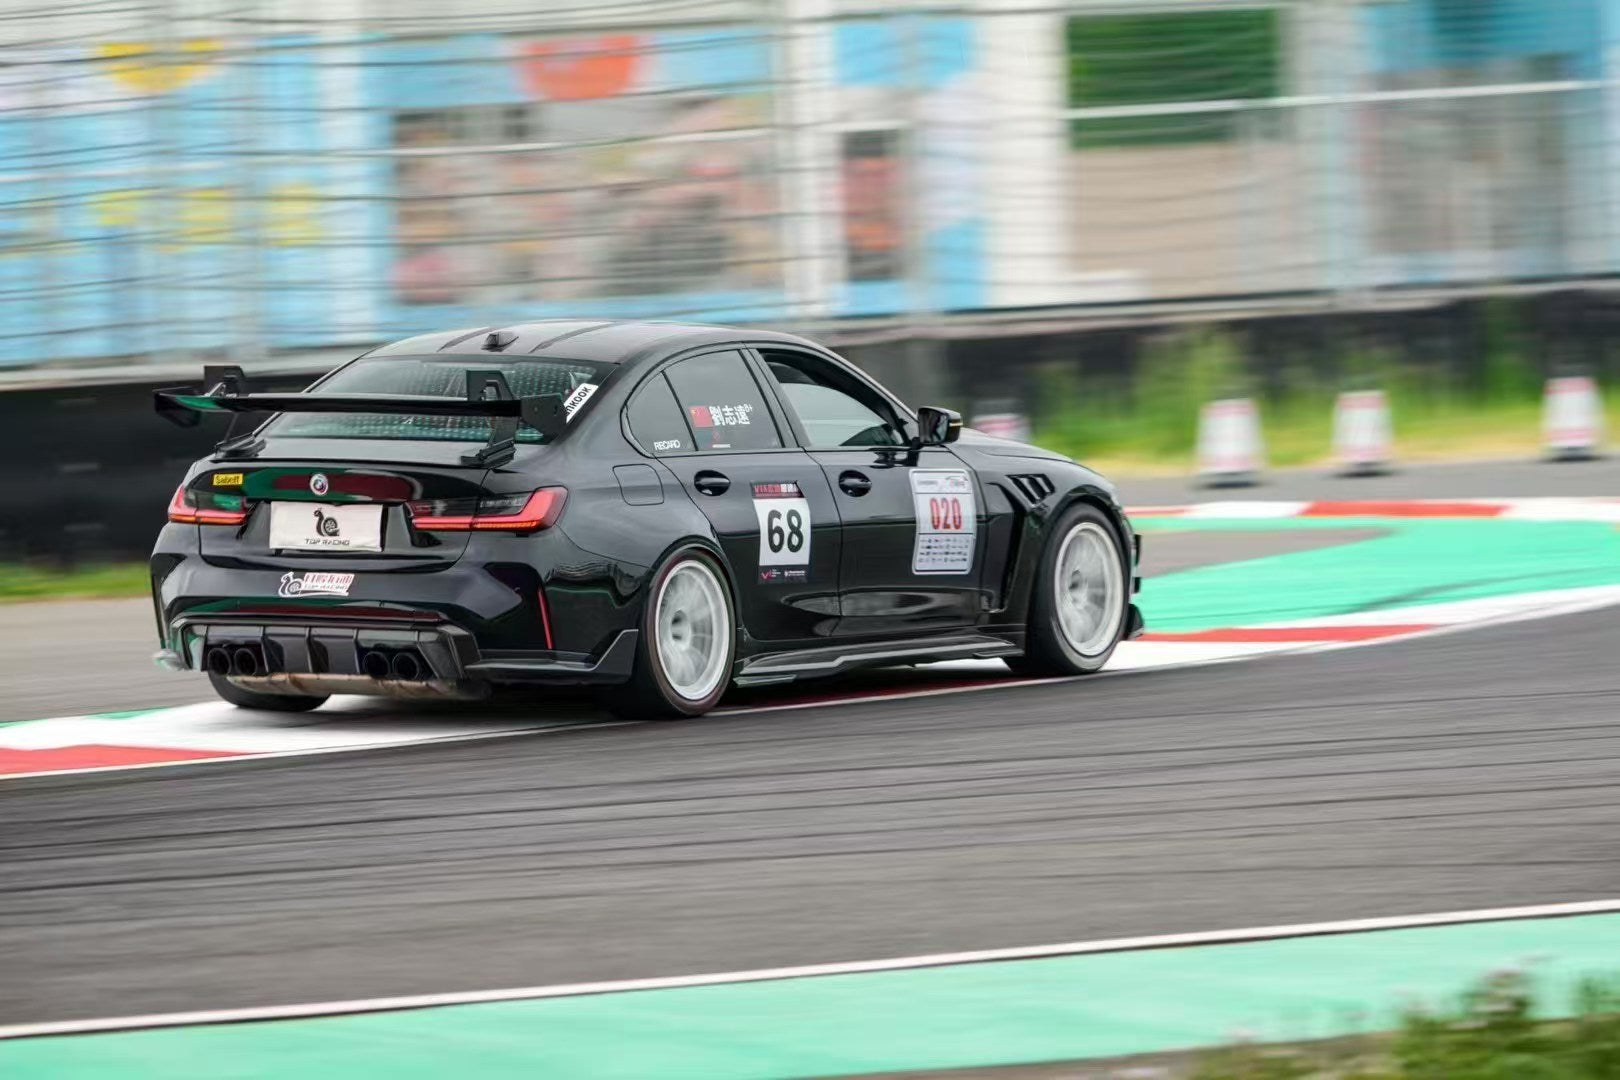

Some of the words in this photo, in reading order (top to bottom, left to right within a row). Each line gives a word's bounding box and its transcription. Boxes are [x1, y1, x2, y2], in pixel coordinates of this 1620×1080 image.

[653, 439, 681, 451] RECARO
[930, 496, 962, 530] 020
[322, 538, 350, 546] RACING
[767, 508, 804, 553] 68
